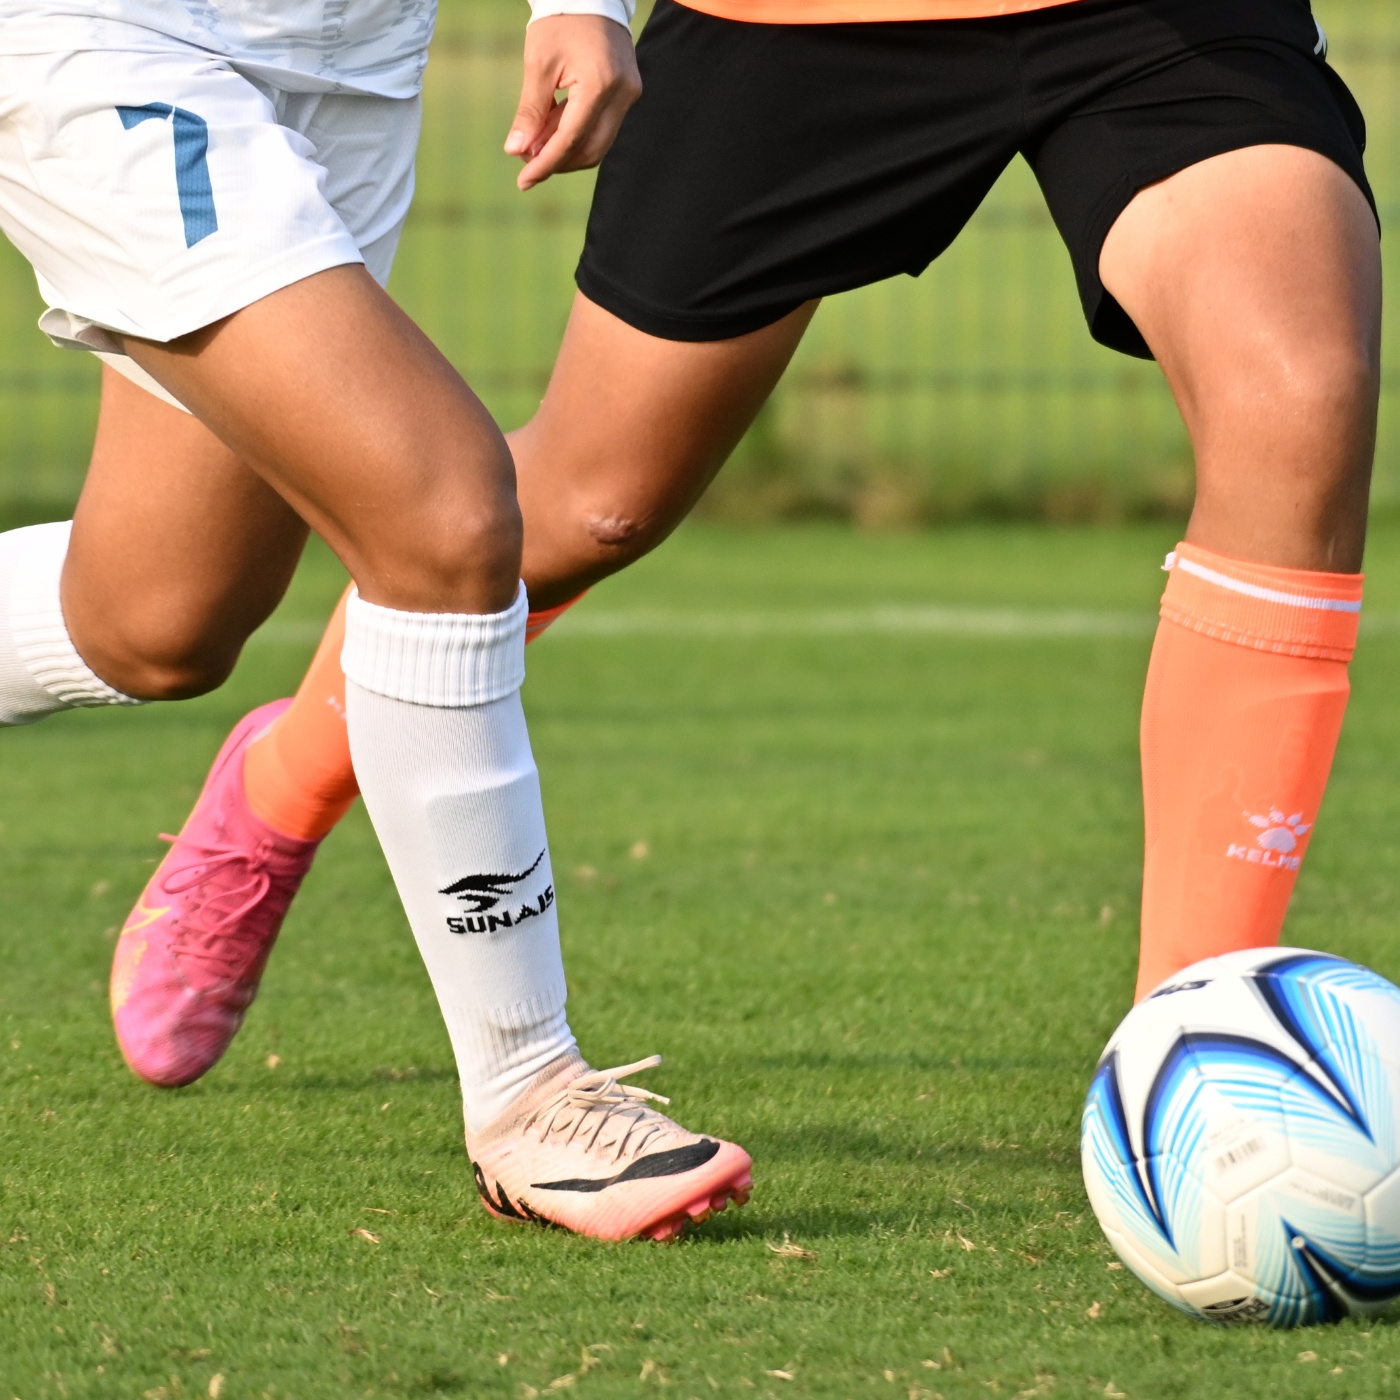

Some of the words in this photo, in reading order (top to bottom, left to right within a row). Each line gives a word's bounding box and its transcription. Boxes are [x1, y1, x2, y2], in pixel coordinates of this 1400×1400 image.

[115, 101, 219, 249] 7
[1225, 843, 1302, 871] KELME
[446, 884, 554, 934] SUNAIS
